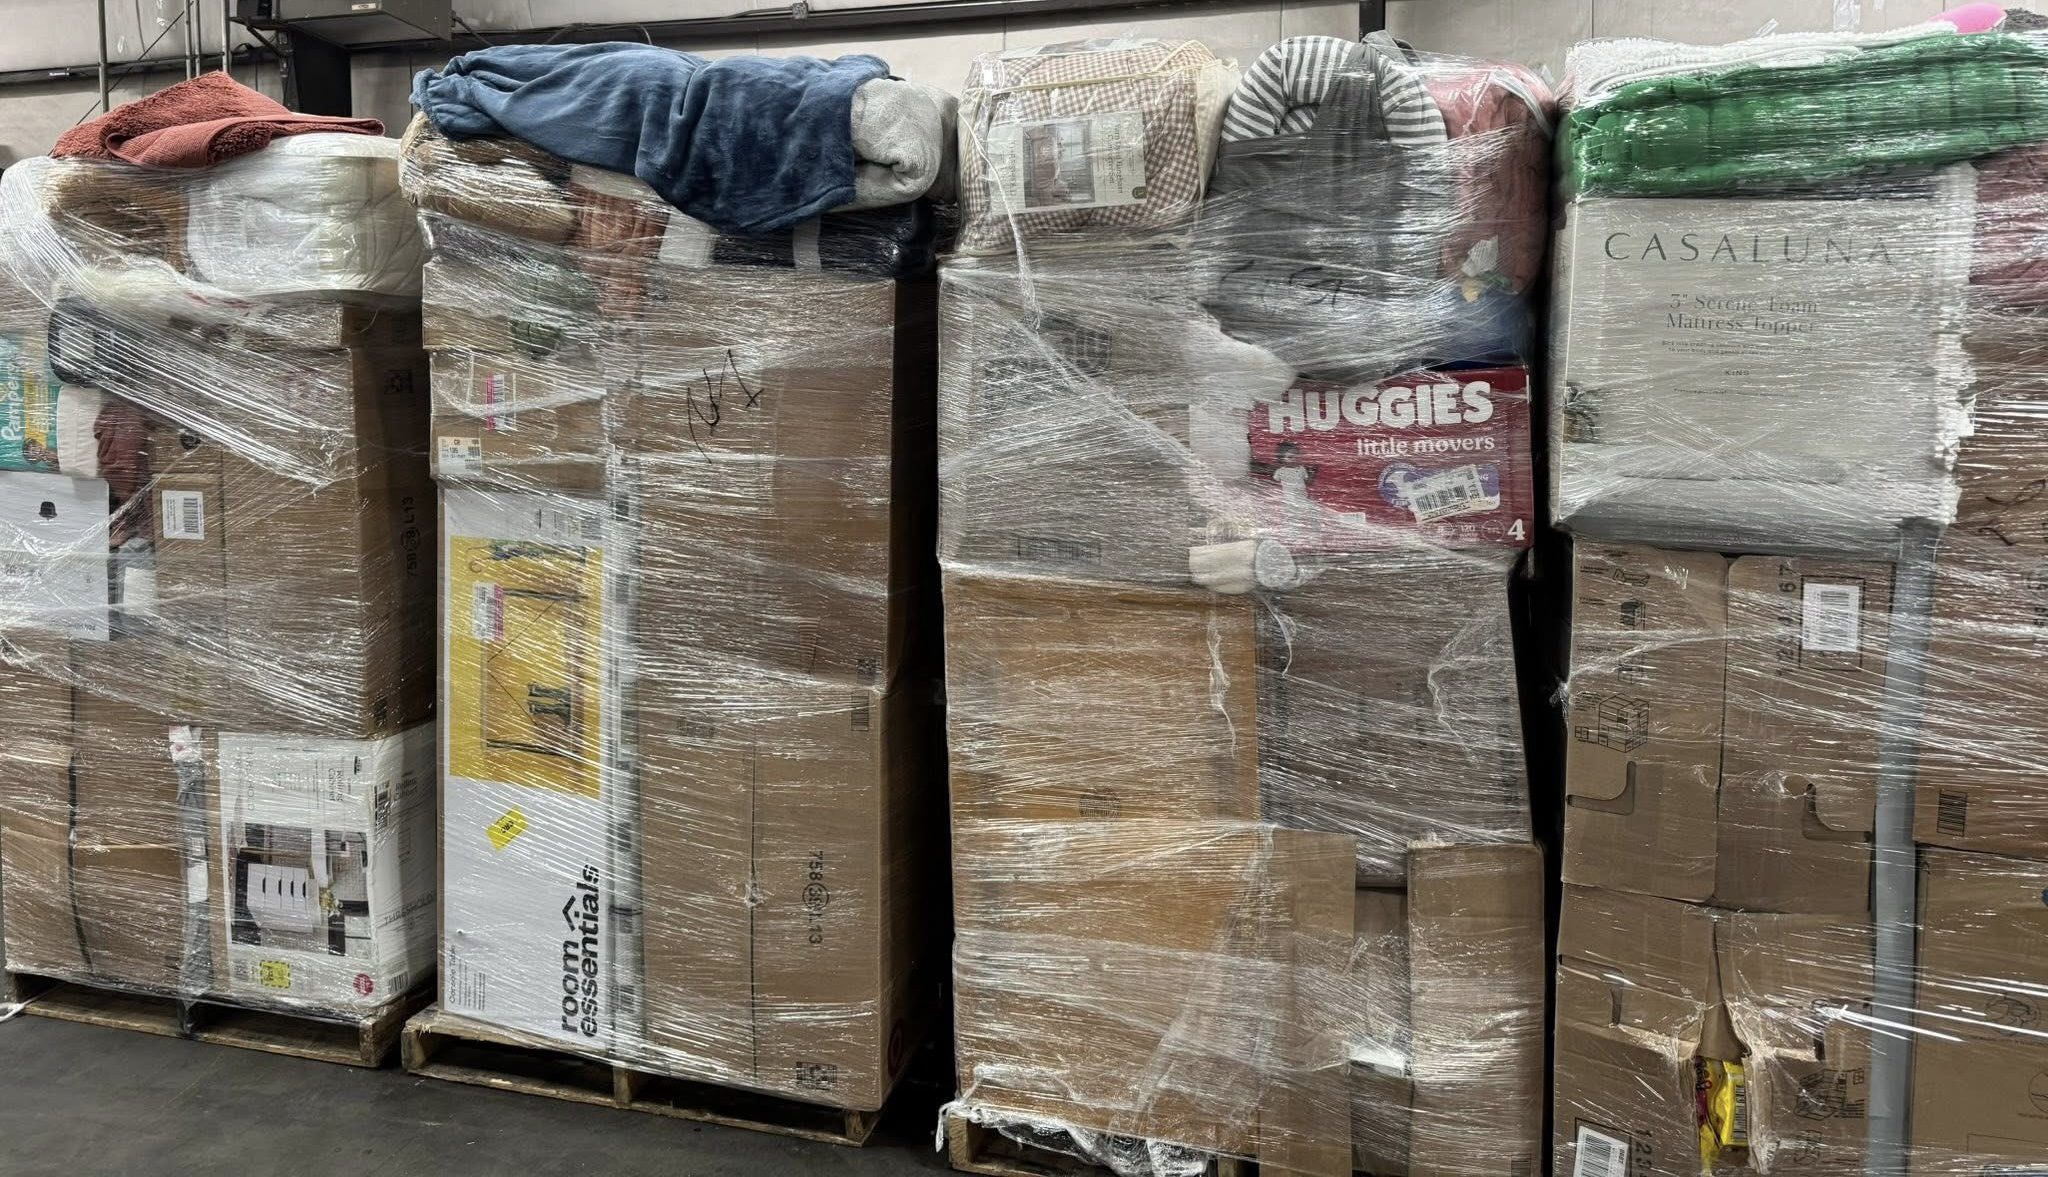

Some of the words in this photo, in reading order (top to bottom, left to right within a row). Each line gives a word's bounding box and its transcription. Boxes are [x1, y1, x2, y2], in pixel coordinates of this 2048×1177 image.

[1604, 232, 1895, 266] CASALUNA
[1694, 295, 1754, 311] Serene
[1666, 313, 1745, 330] Mattress
[1753, 317, 1815, 334] Topper
[1268, 381, 1494, 434] HUGGIES
[1356, 437, 1408, 456] little
[1413, 435, 1495, 453] movers
[1507, 519, 1526, 541] 4
[574, 864, 600, 1038] essentials
[561, 940, 579, 1033] room
